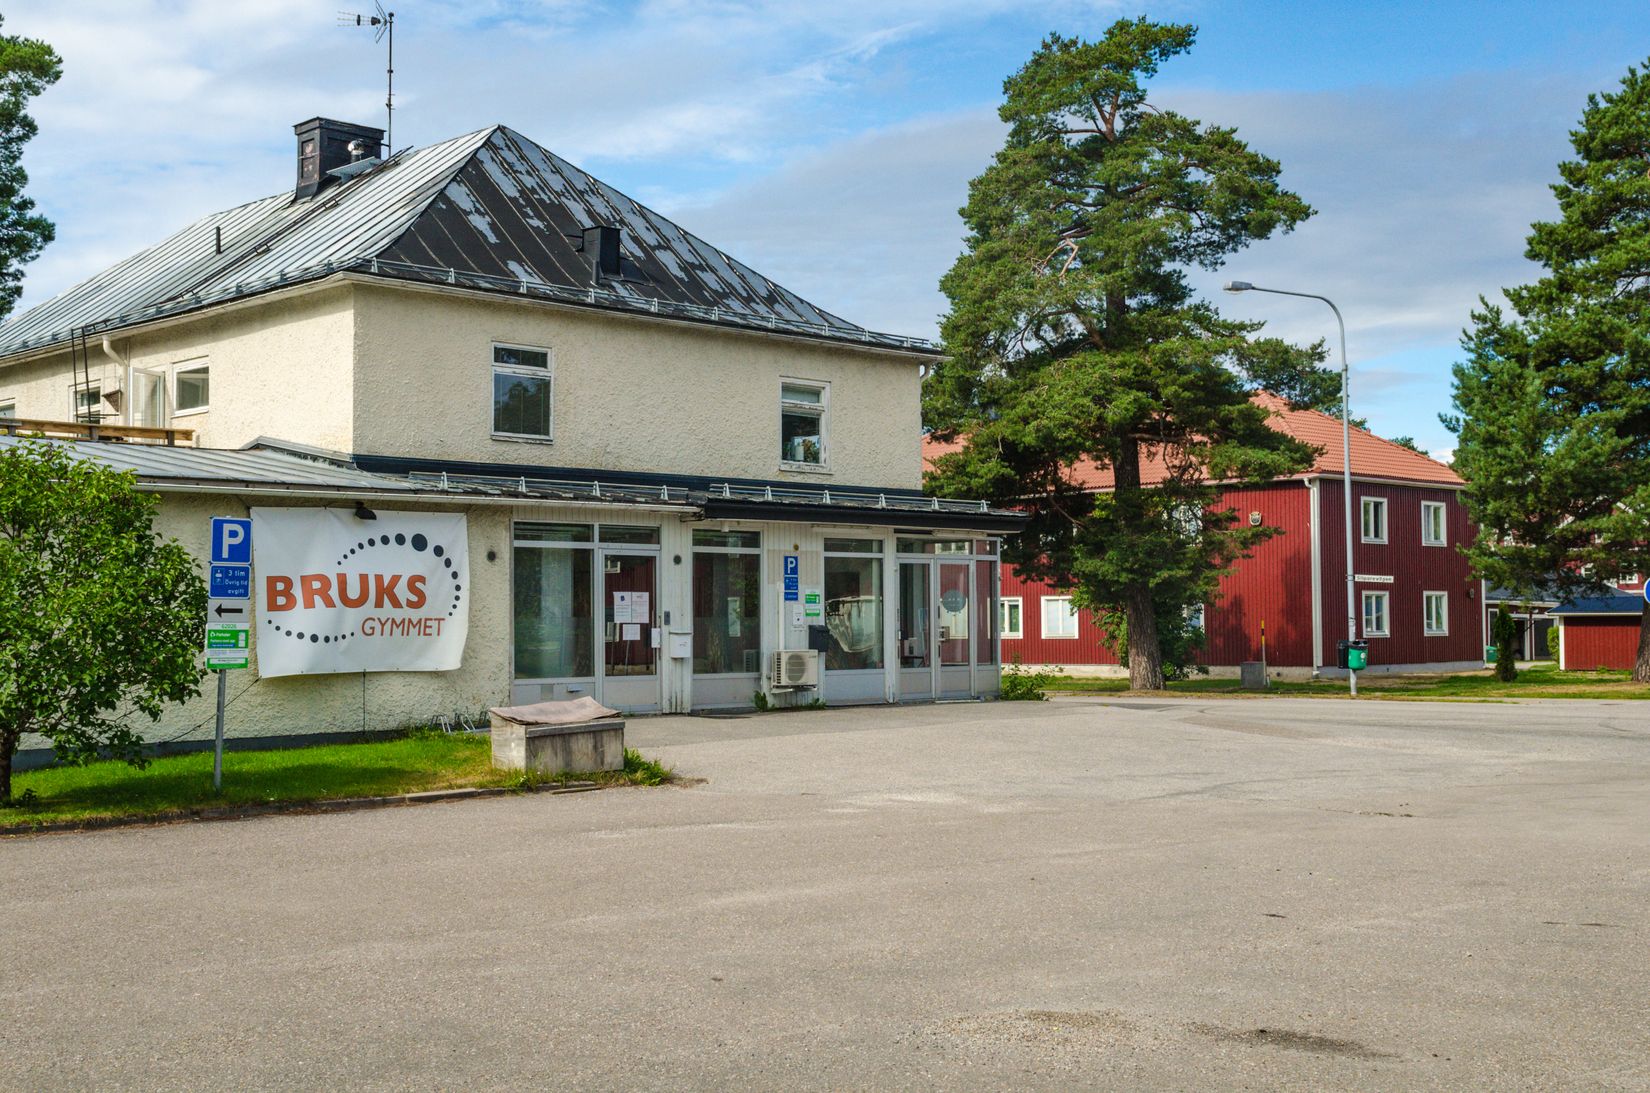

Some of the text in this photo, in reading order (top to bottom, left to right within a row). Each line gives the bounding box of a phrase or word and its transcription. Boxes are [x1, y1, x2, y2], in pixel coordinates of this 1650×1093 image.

[222, 523, 245, 559] P
[227, 569, 246, 577] 3 tim
[787, 557, 796, 574] P
[266, 572, 427, 612] BRUKS
[361, 617, 446, 637] GYMMET
